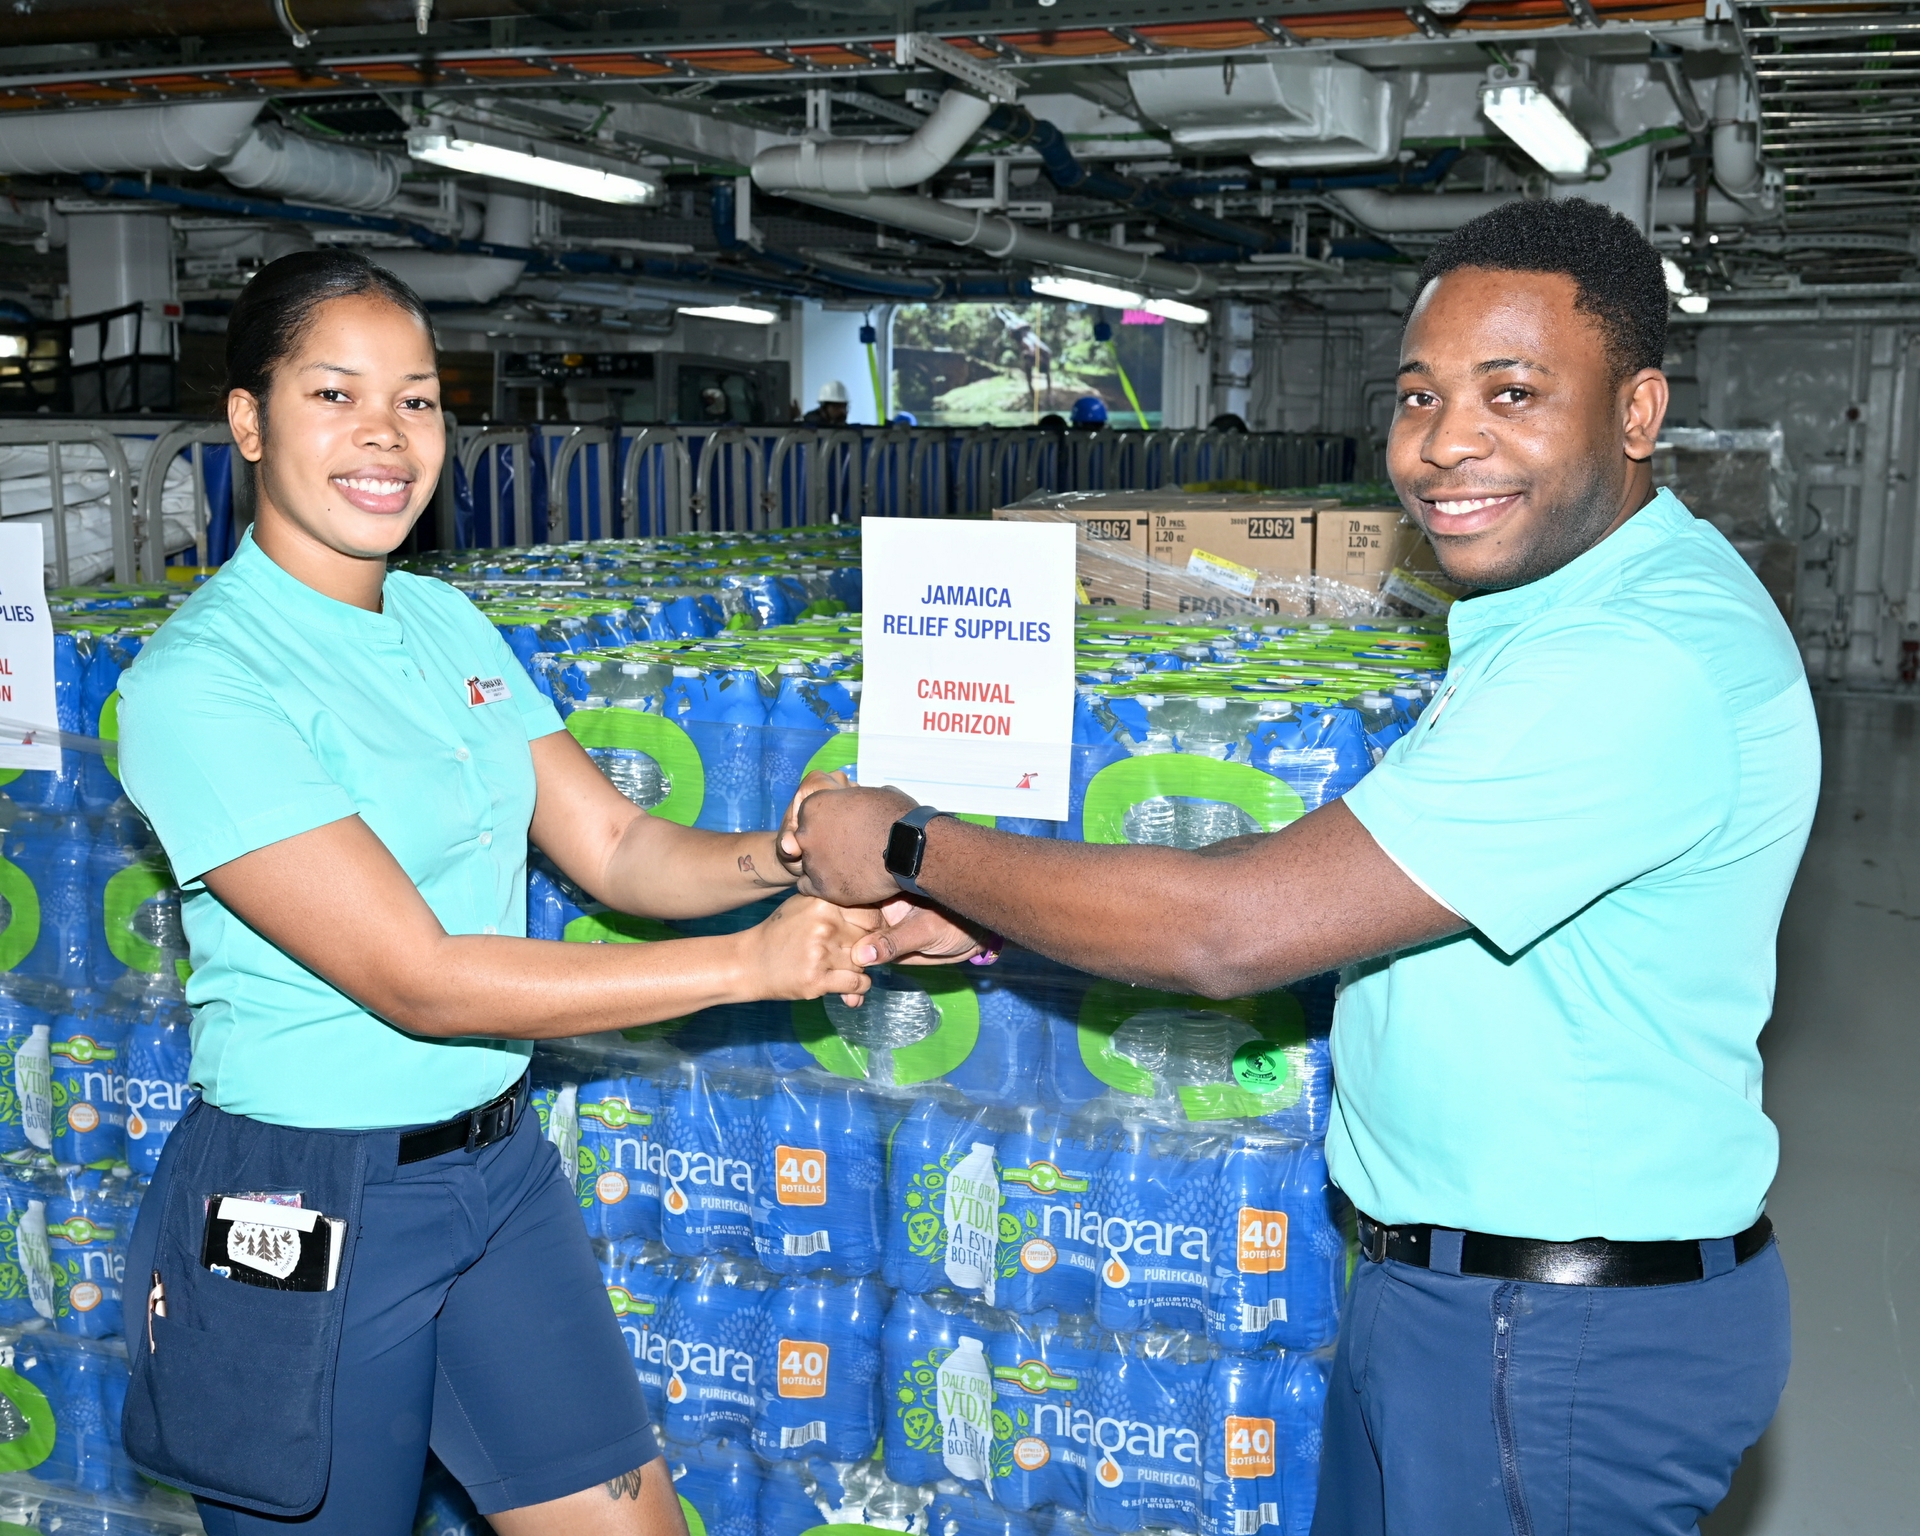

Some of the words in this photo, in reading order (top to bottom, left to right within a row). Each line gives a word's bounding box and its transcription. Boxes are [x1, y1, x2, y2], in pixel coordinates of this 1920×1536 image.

[1088, 520, 1130, 539] 21962
[1155, 516, 1166, 528] 70
[1249, 518, 1293, 538] 21962
[1348, 520, 1360, 532] 70
[1363, 525, 1382, 533] PKGS.
[1155, 531, 1174, 542] 1.20
[1348, 536, 1368, 548] 1.20
[921, 584, 1012, 608] JAMAICA
[883, 614, 949, 637] RELIEF
[954, 617, 1051, 643] SUPPLIES
[917, 678, 1015, 704] CARNIVAL
[922, 711, 1011, 736] HORIZON
[615, 1134, 755, 1214] niagara
[780, 1157, 821, 1184] 40
[781, 1184, 822, 1194] BOTELLAS
[952, 1175, 976, 1199] DALE
[979, 1182, 996, 1205] OTRA
[950, 1195, 995, 1236] VIDA
[952, 1223, 963, 1244] A
[969, 1230, 993, 1261] ESTA
[1242, 1220, 1282, 1248] 40
[1043, 1202, 1211, 1289] niagara
[1242, 1249, 1281, 1260] BOTELLAS
[1070, 1253, 1096, 1271] AGUA
[1144, 1269, 1209, 1289] PURIFICADA
[782, 1351, 823, 1376] 40
[638, 1371, 662, 1387] AGUA
[782, 1377, 822, 1387] BOTELLAS
[942, 1371, 966, 1391] DALE
[969, 1377, 989, 1397] OTRA
[700, 1388, 756, 1407] PURIFICADA
[941, 1390, 989, 1432] VIDA
[948, 1417, 958, 1437] A
[1034, 1401, 1202, 1488] niagara
[1229, 1428, 1270, 1455] 40
[1062, 1450, 1087, 1470] AGUA
[1230, 1455, 1271, 1466] BOTELLAS
[1137, 1469, 1201, 1490] PURIFICADA
